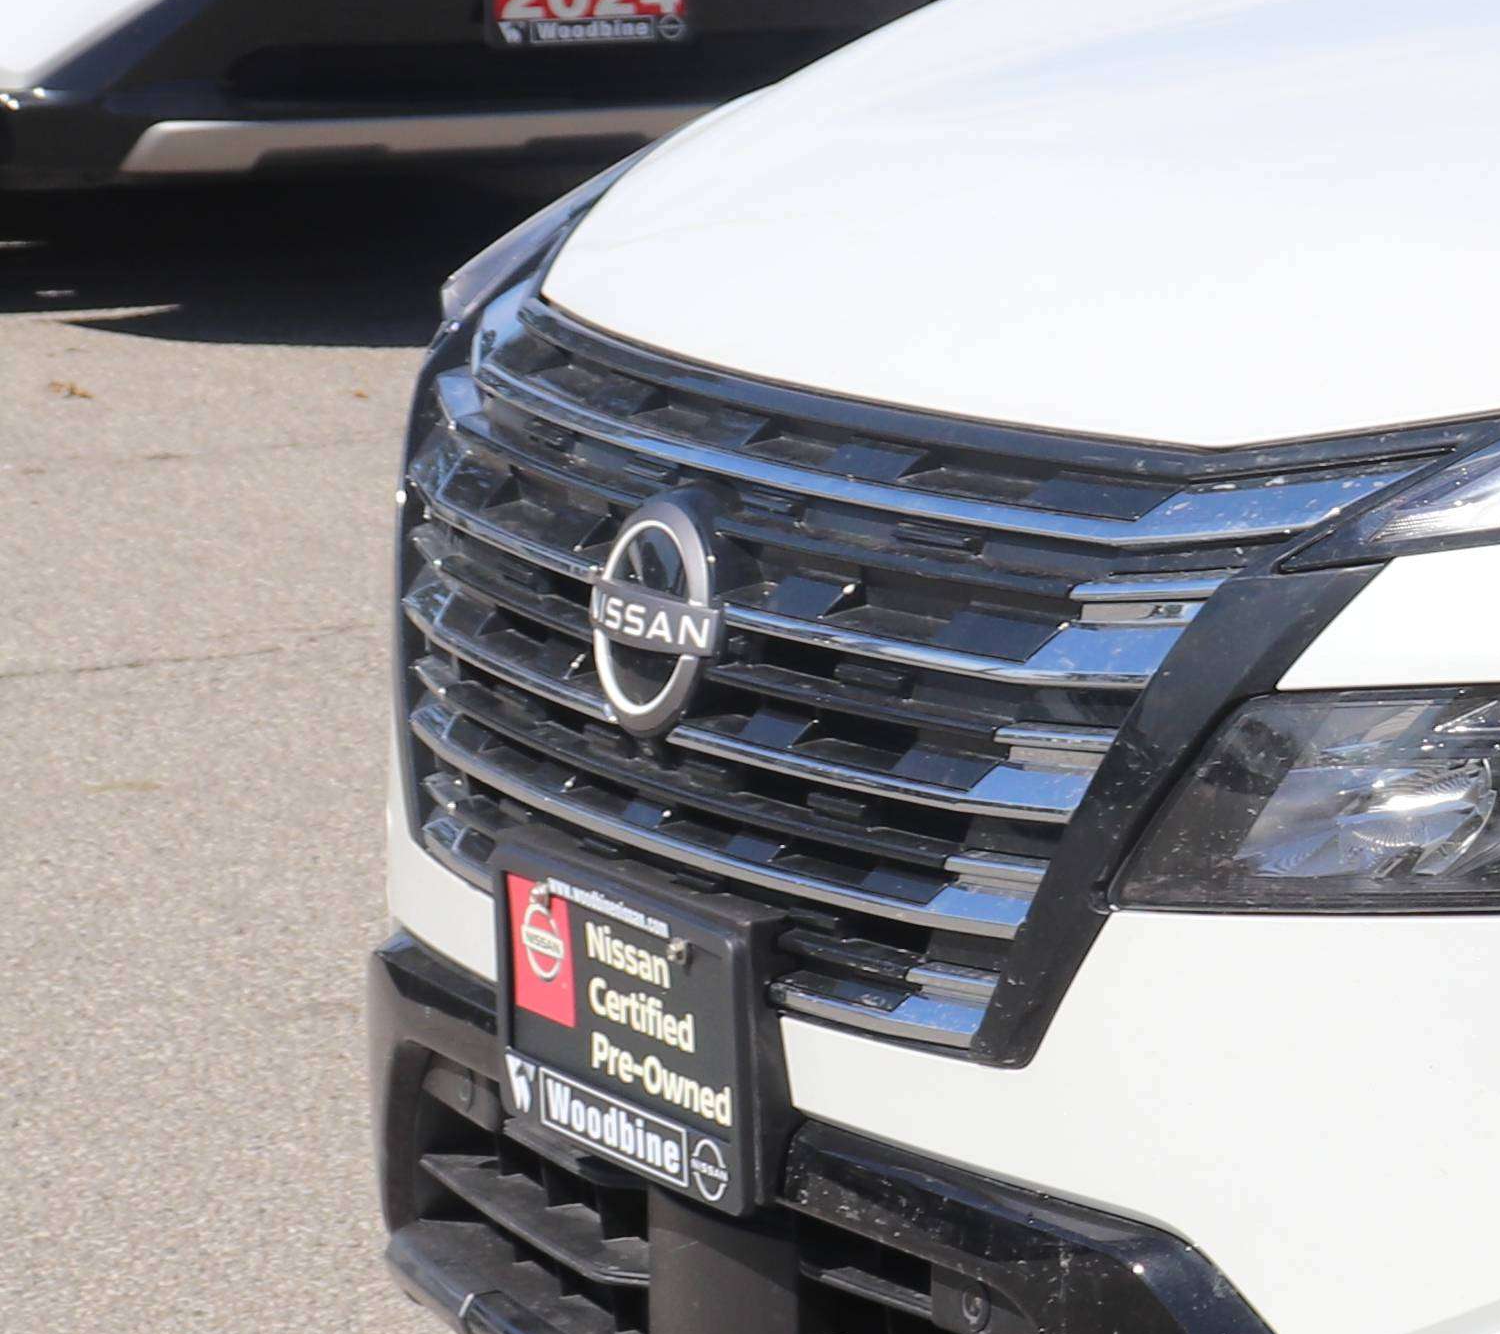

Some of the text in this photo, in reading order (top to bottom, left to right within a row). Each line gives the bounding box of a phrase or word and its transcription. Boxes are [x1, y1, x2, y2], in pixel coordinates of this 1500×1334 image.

[536, 20, 650, 40] Woodbine
[585, 921, 670, 989] Nissan
[589, 976, 695, 1053] Certified
[591, 1031, 732, 1127] Pre-Owned
[546, 1078, 680, 1174] Woodbine
[690, 1158, 728, 1182] NISSAN
